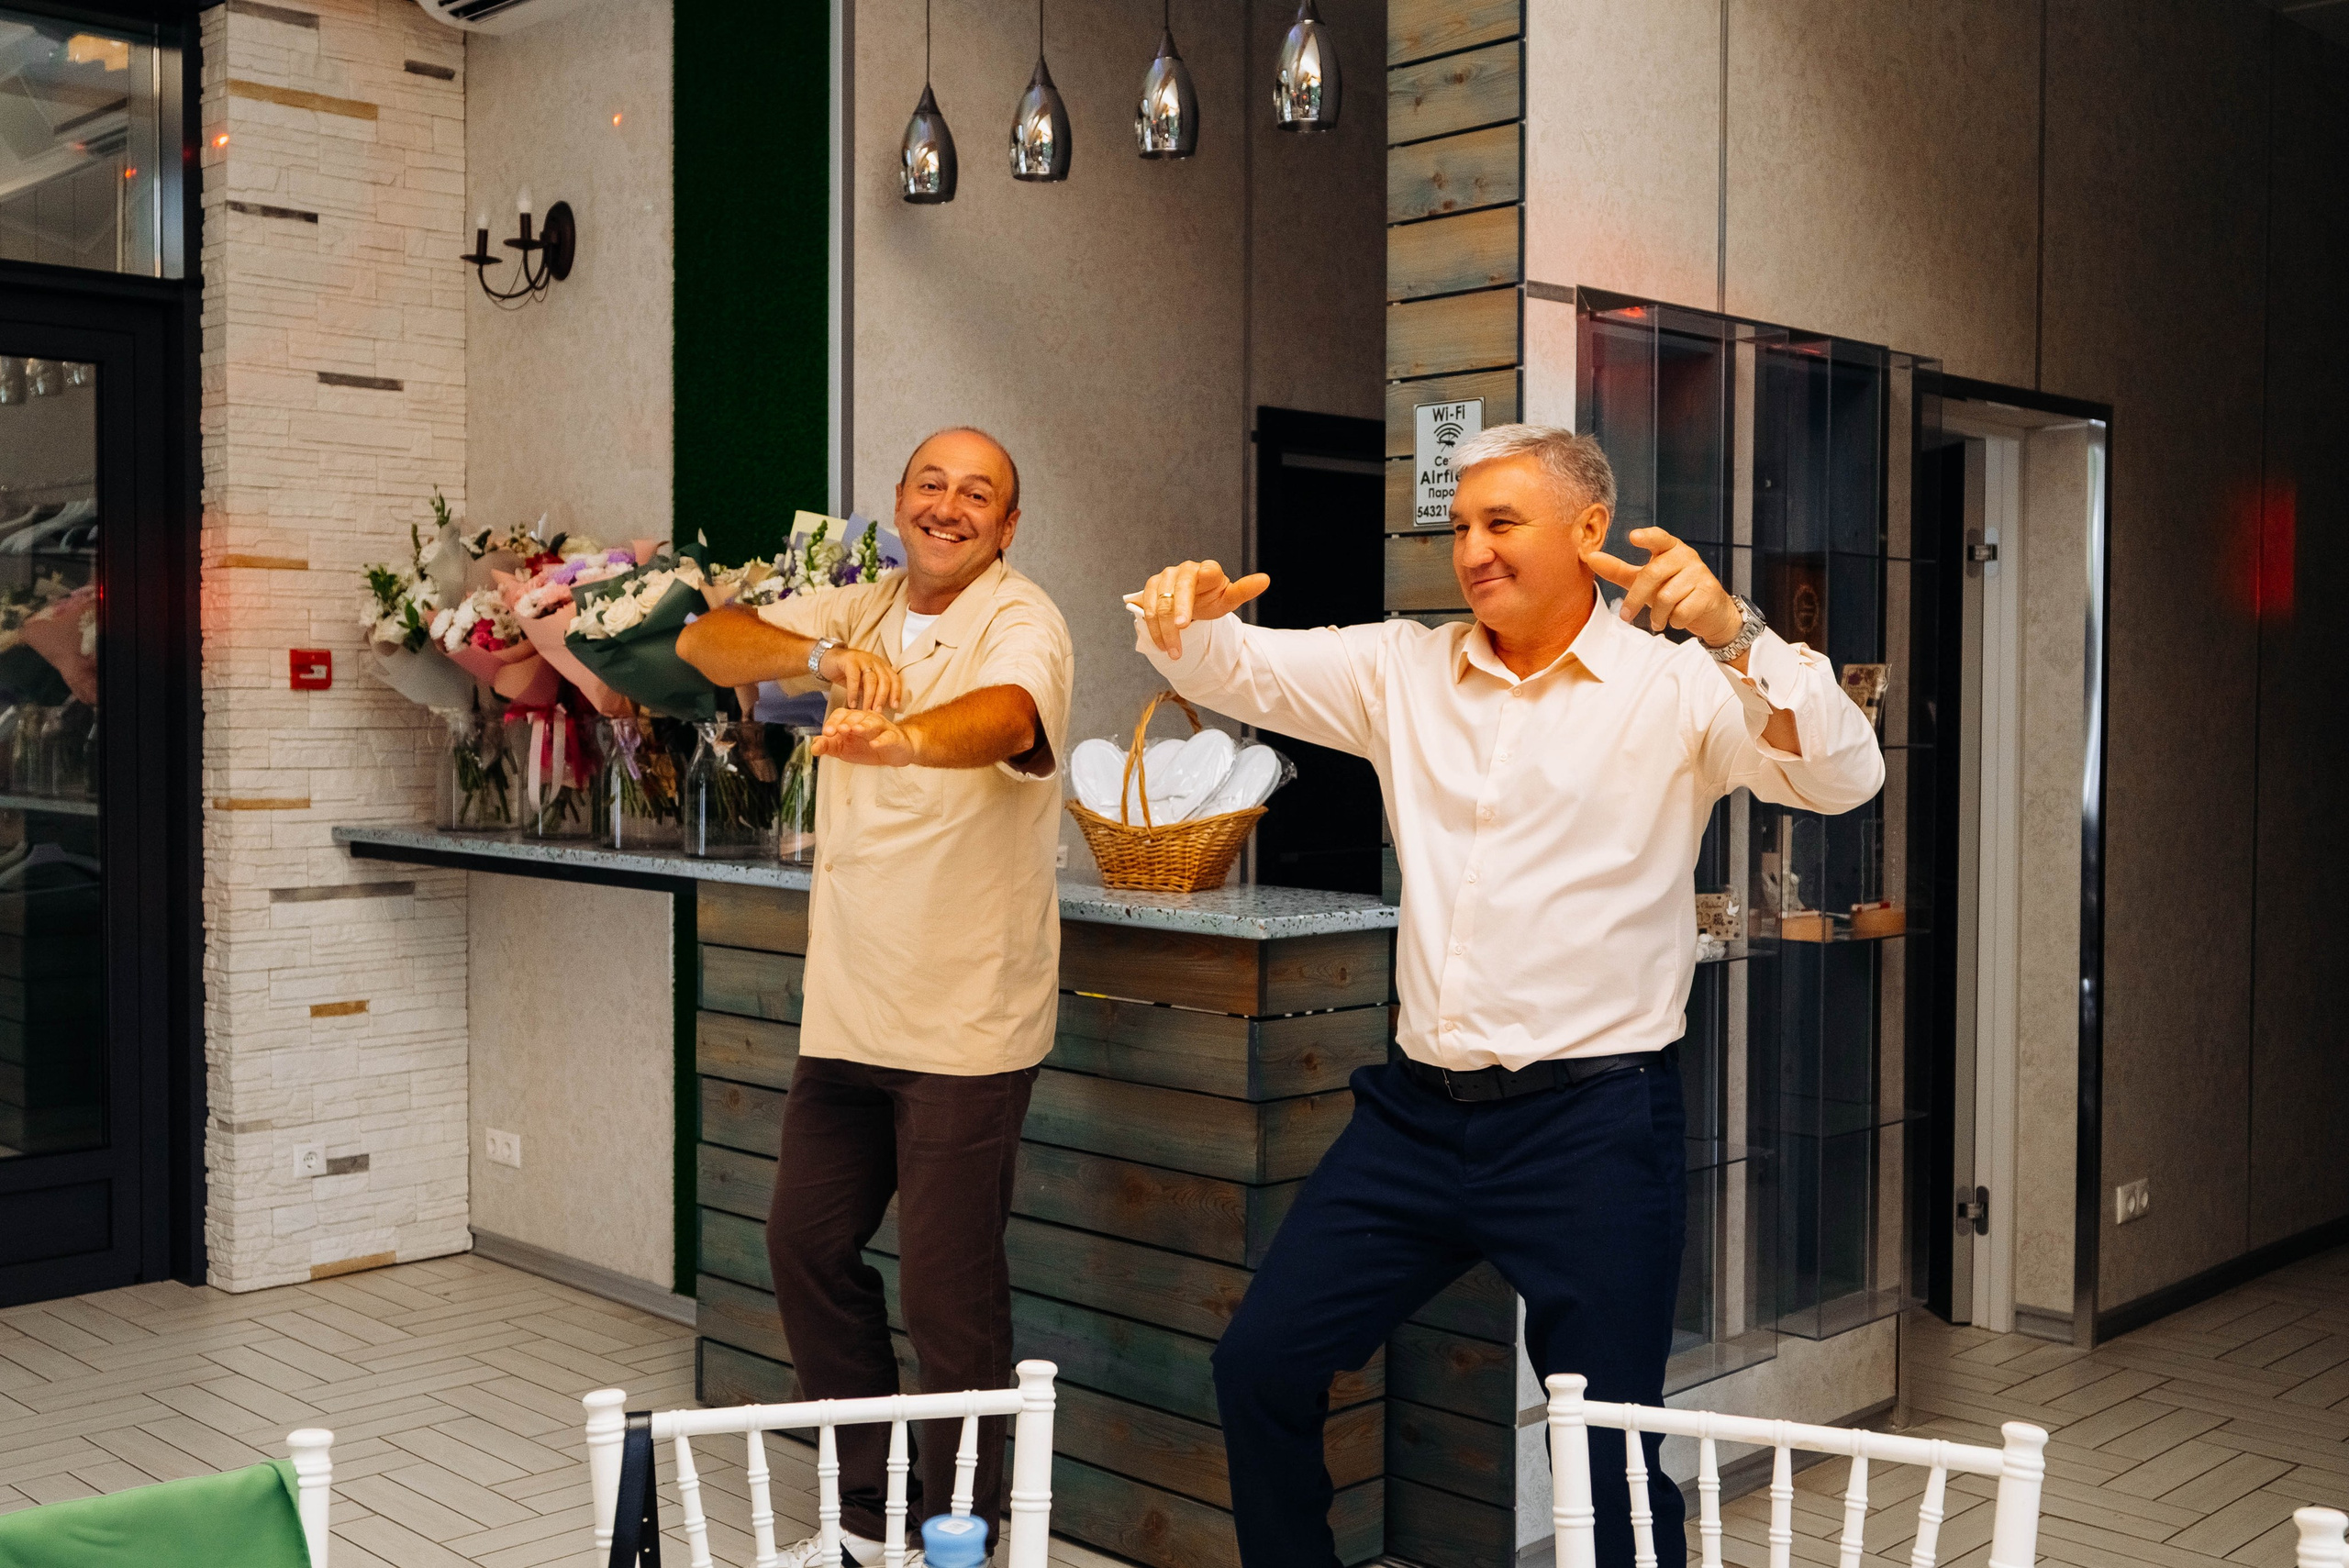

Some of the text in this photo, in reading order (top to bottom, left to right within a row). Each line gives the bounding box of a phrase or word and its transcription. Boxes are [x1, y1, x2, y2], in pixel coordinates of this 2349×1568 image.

[1432, 405, 1465, 422] Wi-Fi
[1434, 455, 1452, 467] Се
[1428, 487, 1455, 500] Паро
